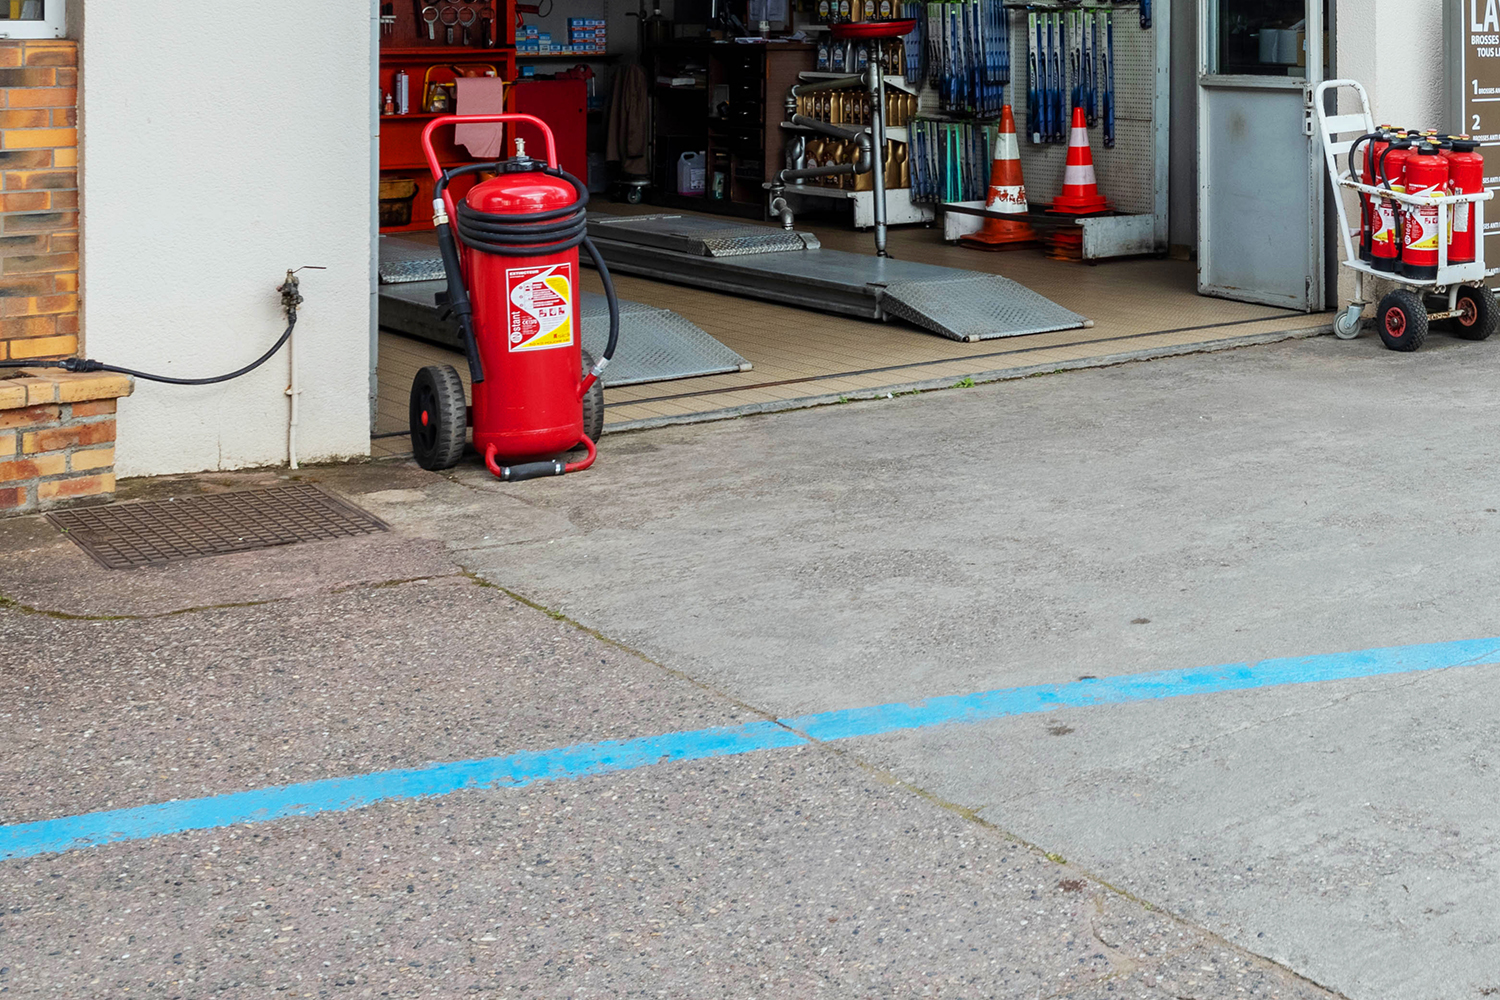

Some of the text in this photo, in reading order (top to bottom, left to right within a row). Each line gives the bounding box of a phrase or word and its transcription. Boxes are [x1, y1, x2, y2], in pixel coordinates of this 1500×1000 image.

[1471, 35, 1499, 45] BROSSES
[1477, 47, 1495, 57] TOUS
[1472, 79, 1478, 95] 1
[1472, 114, 1481, 130] 2
